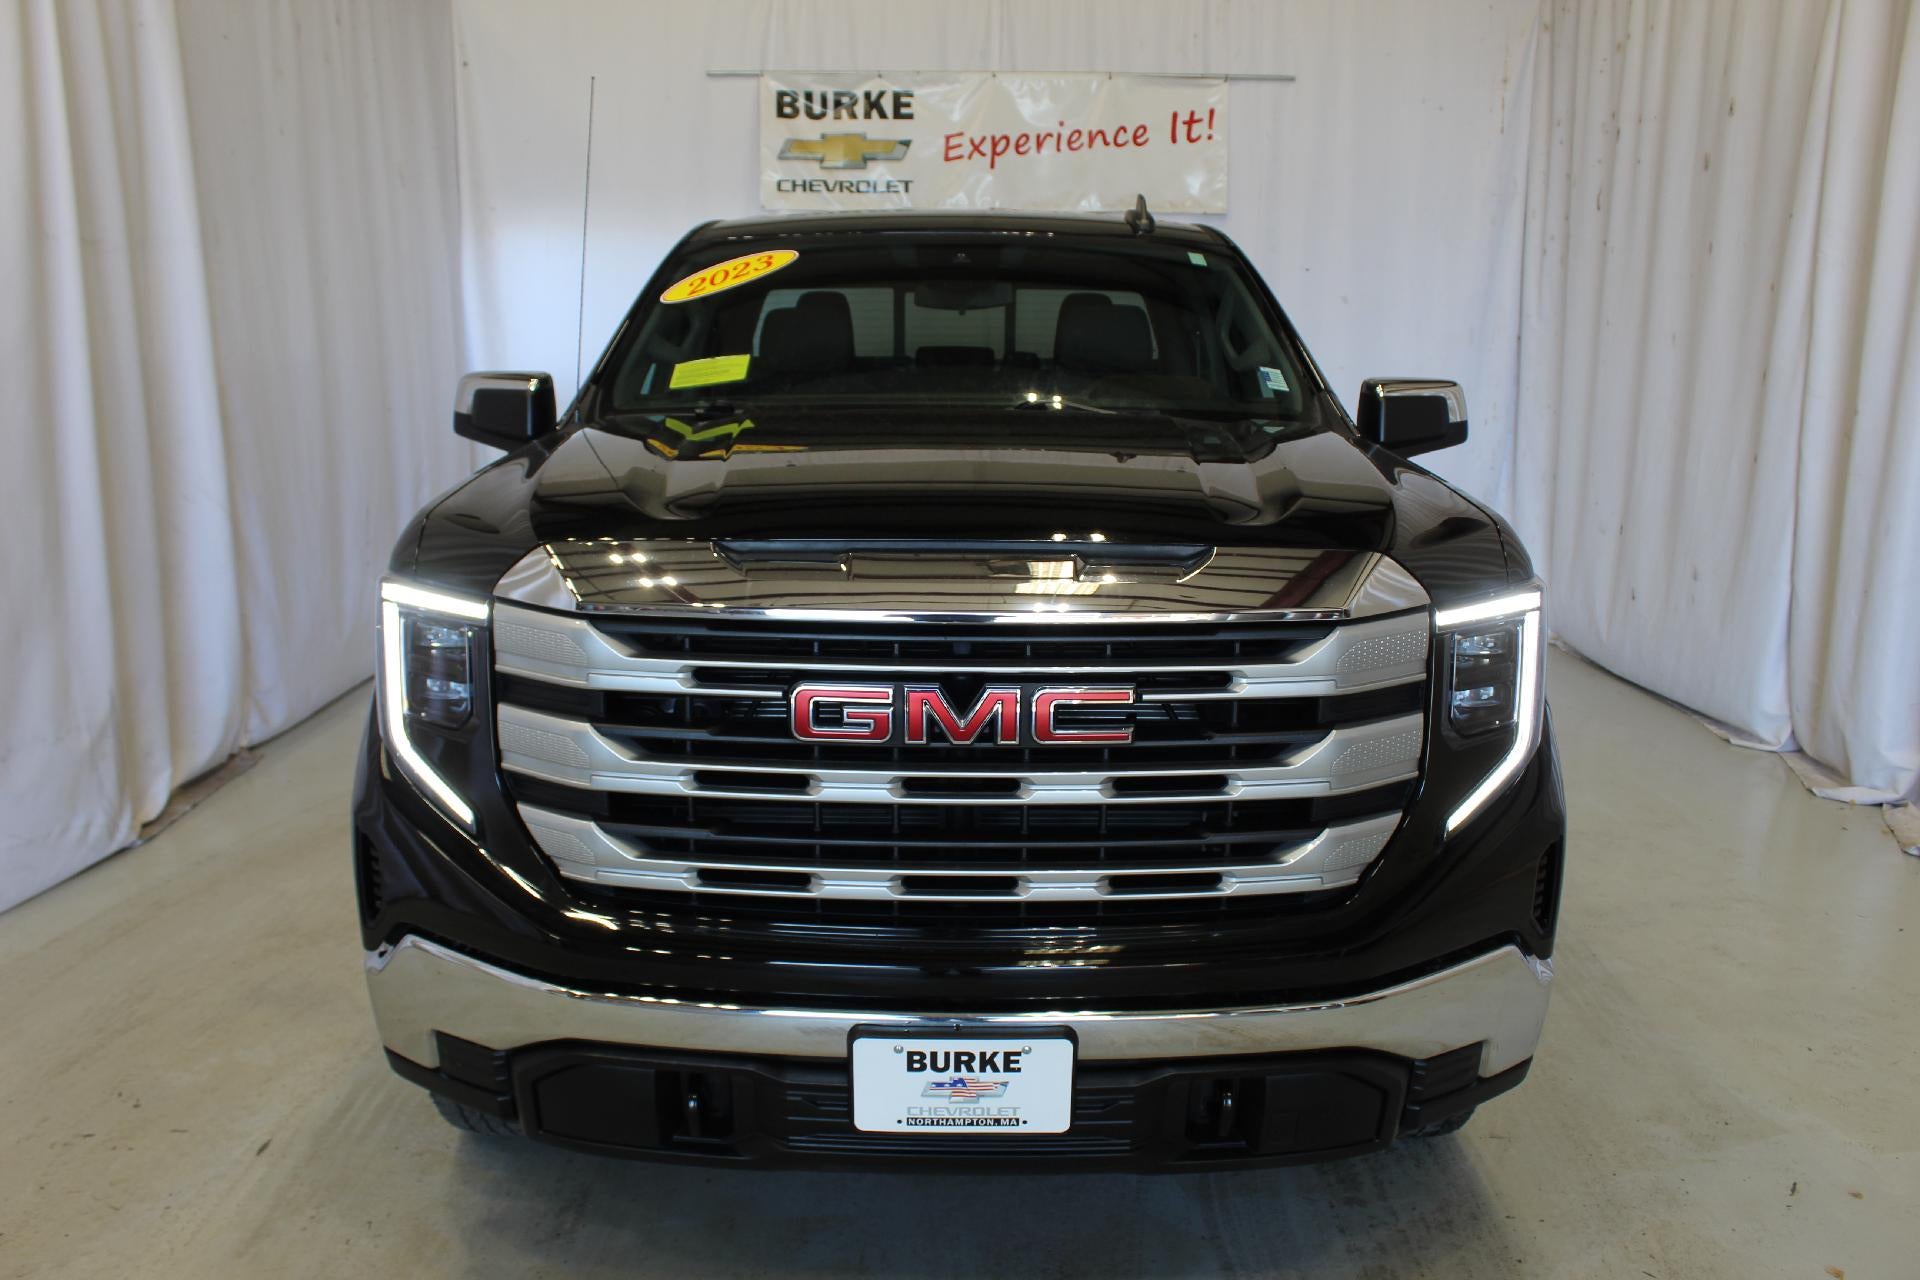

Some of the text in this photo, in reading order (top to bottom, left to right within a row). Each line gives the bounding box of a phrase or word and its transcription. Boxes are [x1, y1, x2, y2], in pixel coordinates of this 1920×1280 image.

[775, 89, 915, 121] BURKE
[942, 108, 1216, 168] Experience It!
[776, 178, 914, 194] CHEVROLET
[687, 254, 774, 296] 2023
[790, 682, 1136, 744] GMC
[906, 1050, 1022, 1073] BURKE
[907, 1106, 1020, 1117] CHEVROLET
[1000, 1118, 1018, 1126] MA
